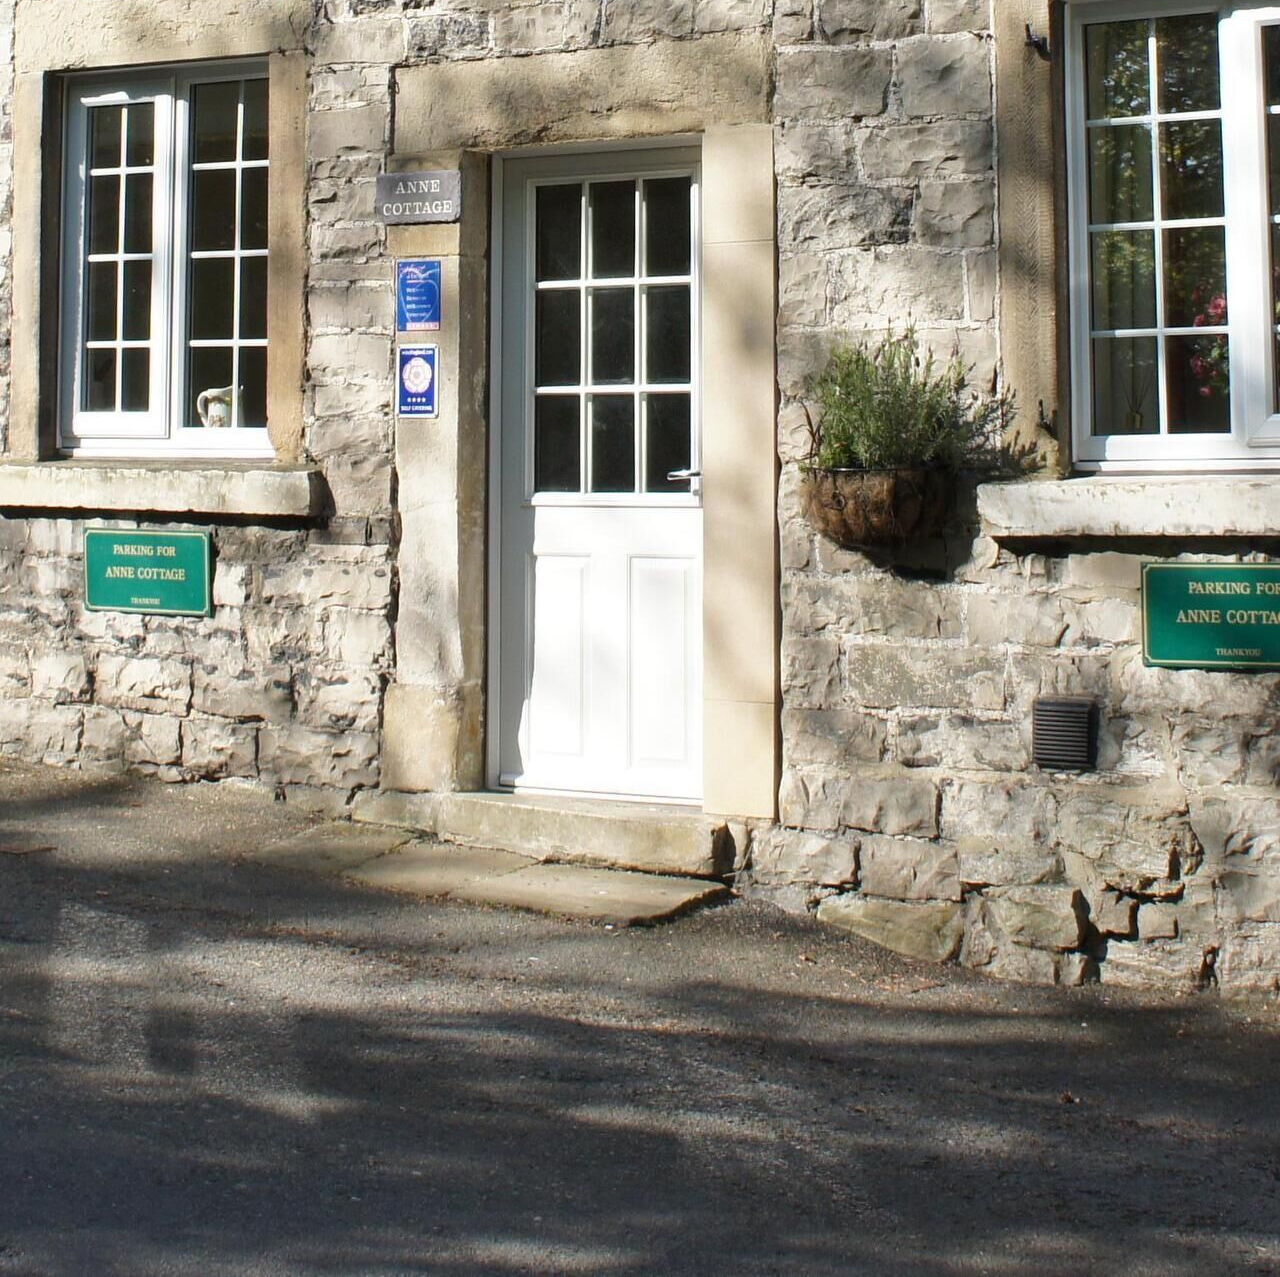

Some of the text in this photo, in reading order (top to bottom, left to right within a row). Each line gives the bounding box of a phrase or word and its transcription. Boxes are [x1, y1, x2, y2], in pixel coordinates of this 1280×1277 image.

[395, 179, 441, 195] ANNE
[382, 200, 453, 216] COTTAGE
[113, 544, 176, 557] PARKING FOR
[105, 566, 186, 581] ANNE COTTAGE
[1188, 581, 1251, 595] PARKING
[1175, 609, 1221, 623] ANNE
